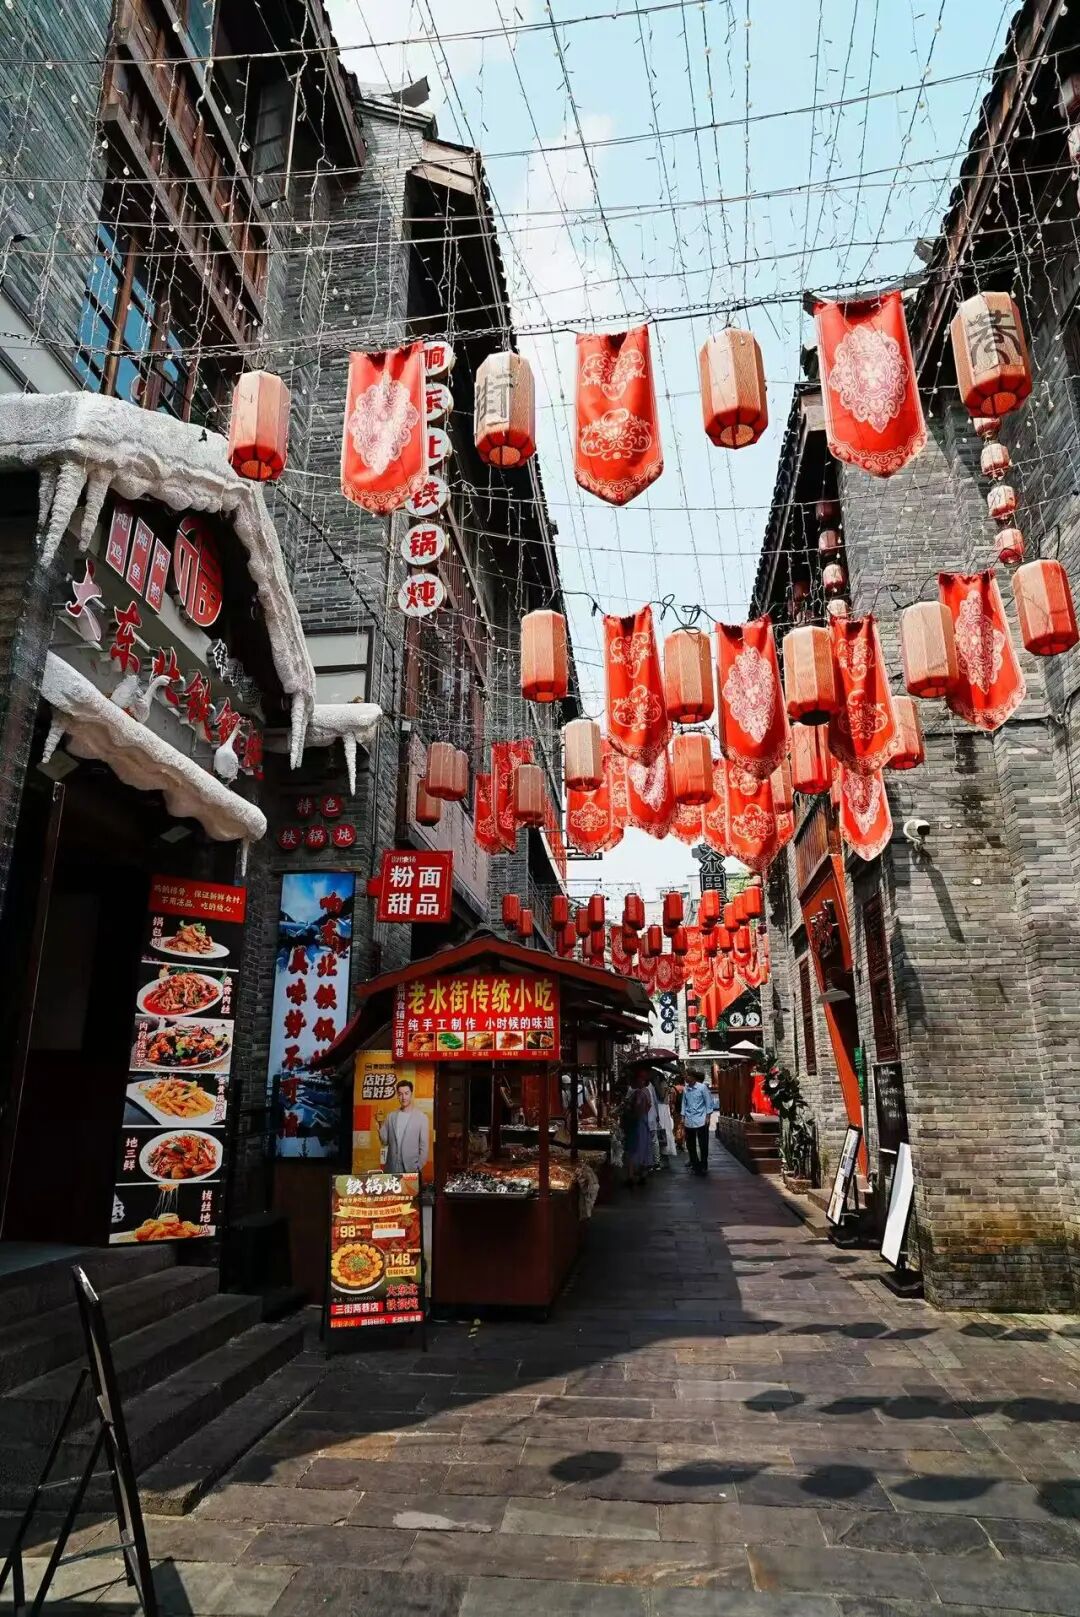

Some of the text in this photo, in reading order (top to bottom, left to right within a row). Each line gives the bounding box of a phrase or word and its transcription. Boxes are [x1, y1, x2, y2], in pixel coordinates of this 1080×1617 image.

[296, 797, 339, 814] 特色
[280, 828, 352, 844] 铁锅炖
[390, 865, 443, 888] 粉面
[387, 893, 440, 915] 甜品
[150, 916, 164, 947] 锅包肉
[220, 976, 234, 1015] 鱼香肉丝
[407, 978, 555, 1015] 老水街传统小吃
[408, 1016, 555, 1031] 纯手工制作 小时候的味道
[363, 1073, 397, 1086] 店好多
[362, 1086, 395, 1100] 省好多
[123, 1137, 139, 1171] 地三鲜
[345, 1176, 402, 1195] 铁锅炖
[199, 1189, 213, 1236] 拔丝地瓜
[339, 1225, 356, 1238] 98
[389, 1253, 411, 1266] 148
[335, 1303, 379, 1314] 三街两巷店
